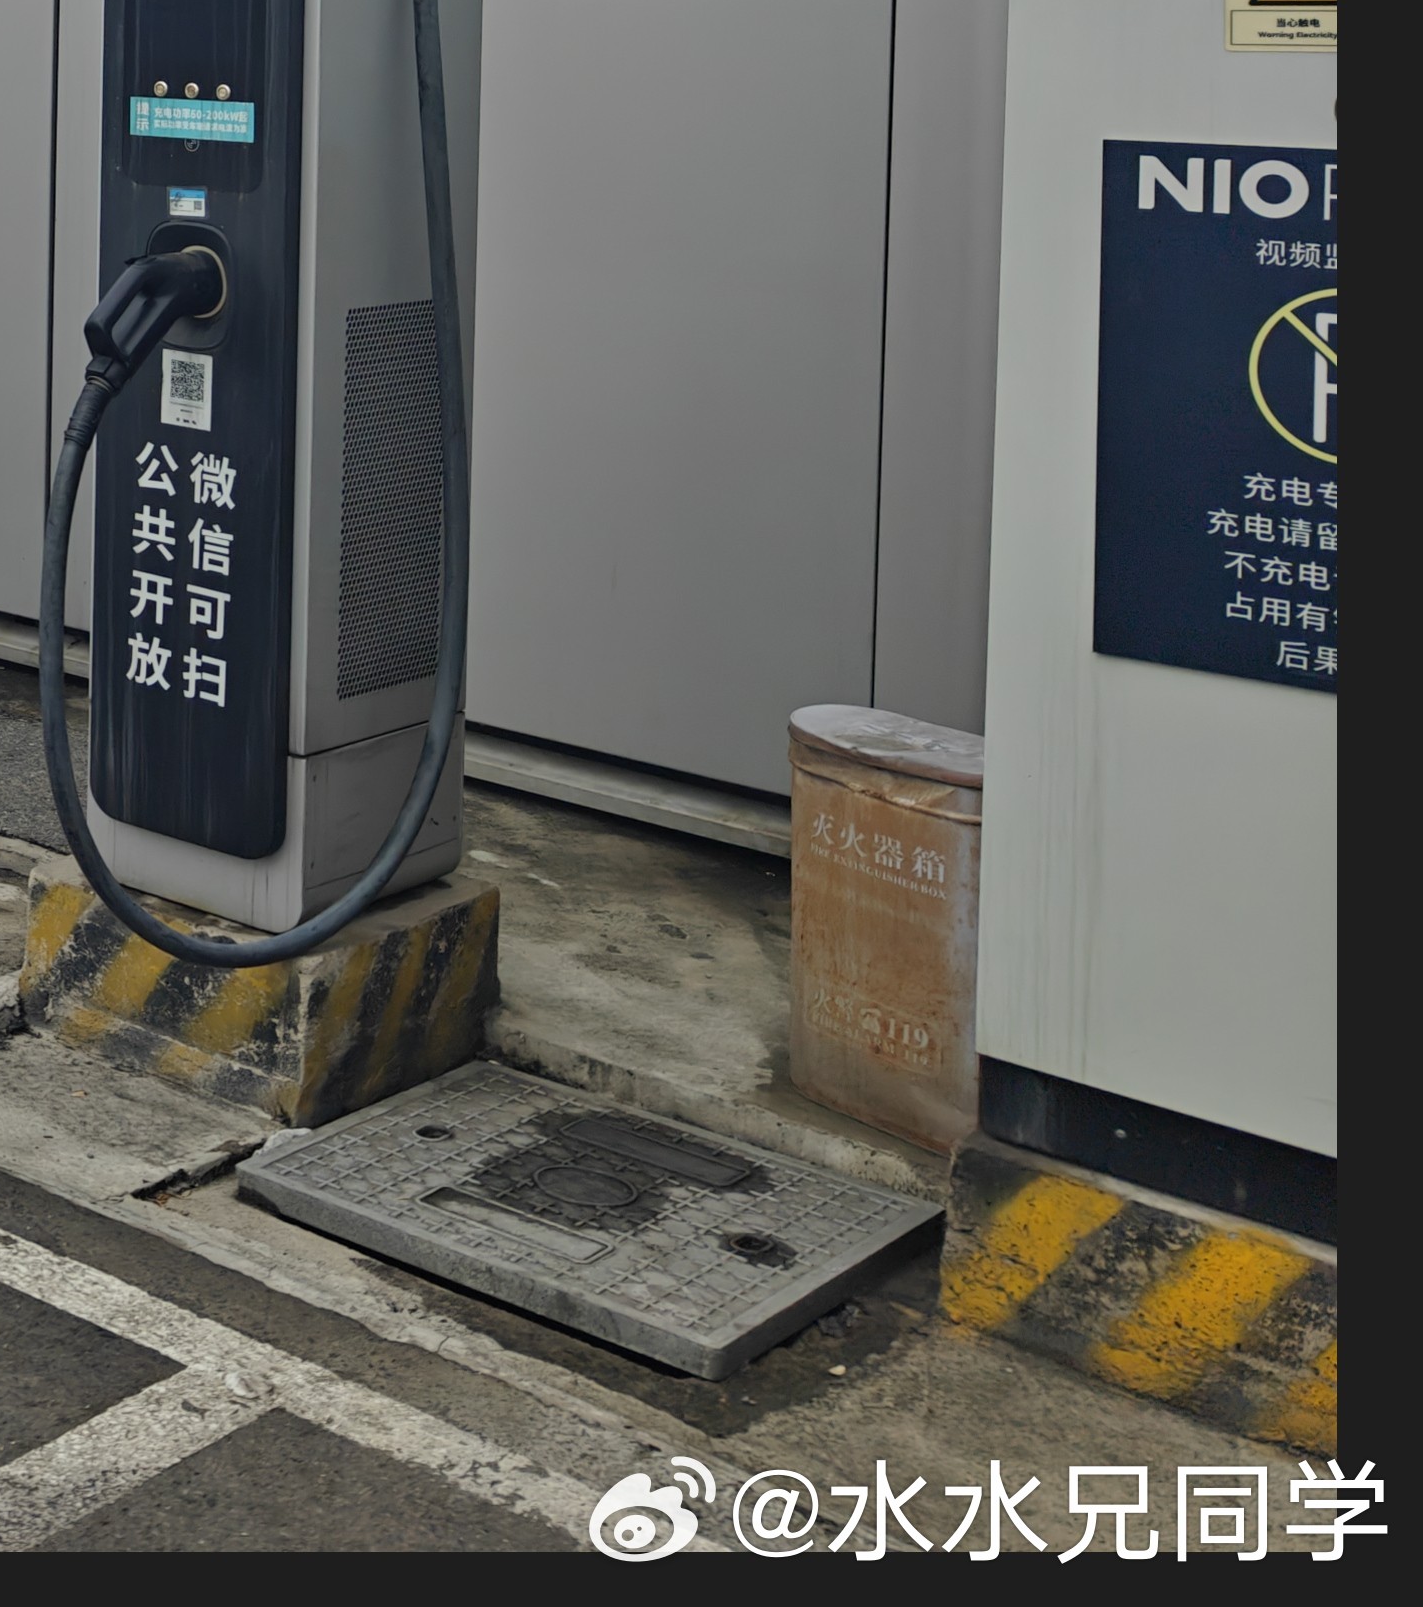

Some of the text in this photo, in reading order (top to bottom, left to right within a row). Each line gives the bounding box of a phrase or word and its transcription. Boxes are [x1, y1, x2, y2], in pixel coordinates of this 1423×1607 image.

[1276, 18, 1320, 28] 当心触电
[126, 441, 179, 691] 公共开放
[183, 451, 237, 707] 微信可扫
[1224, 551, 1337, 591] 不充电
[1225, 591, 1337, 632] 占用有
[888, 1017, 929, 1049] 119
